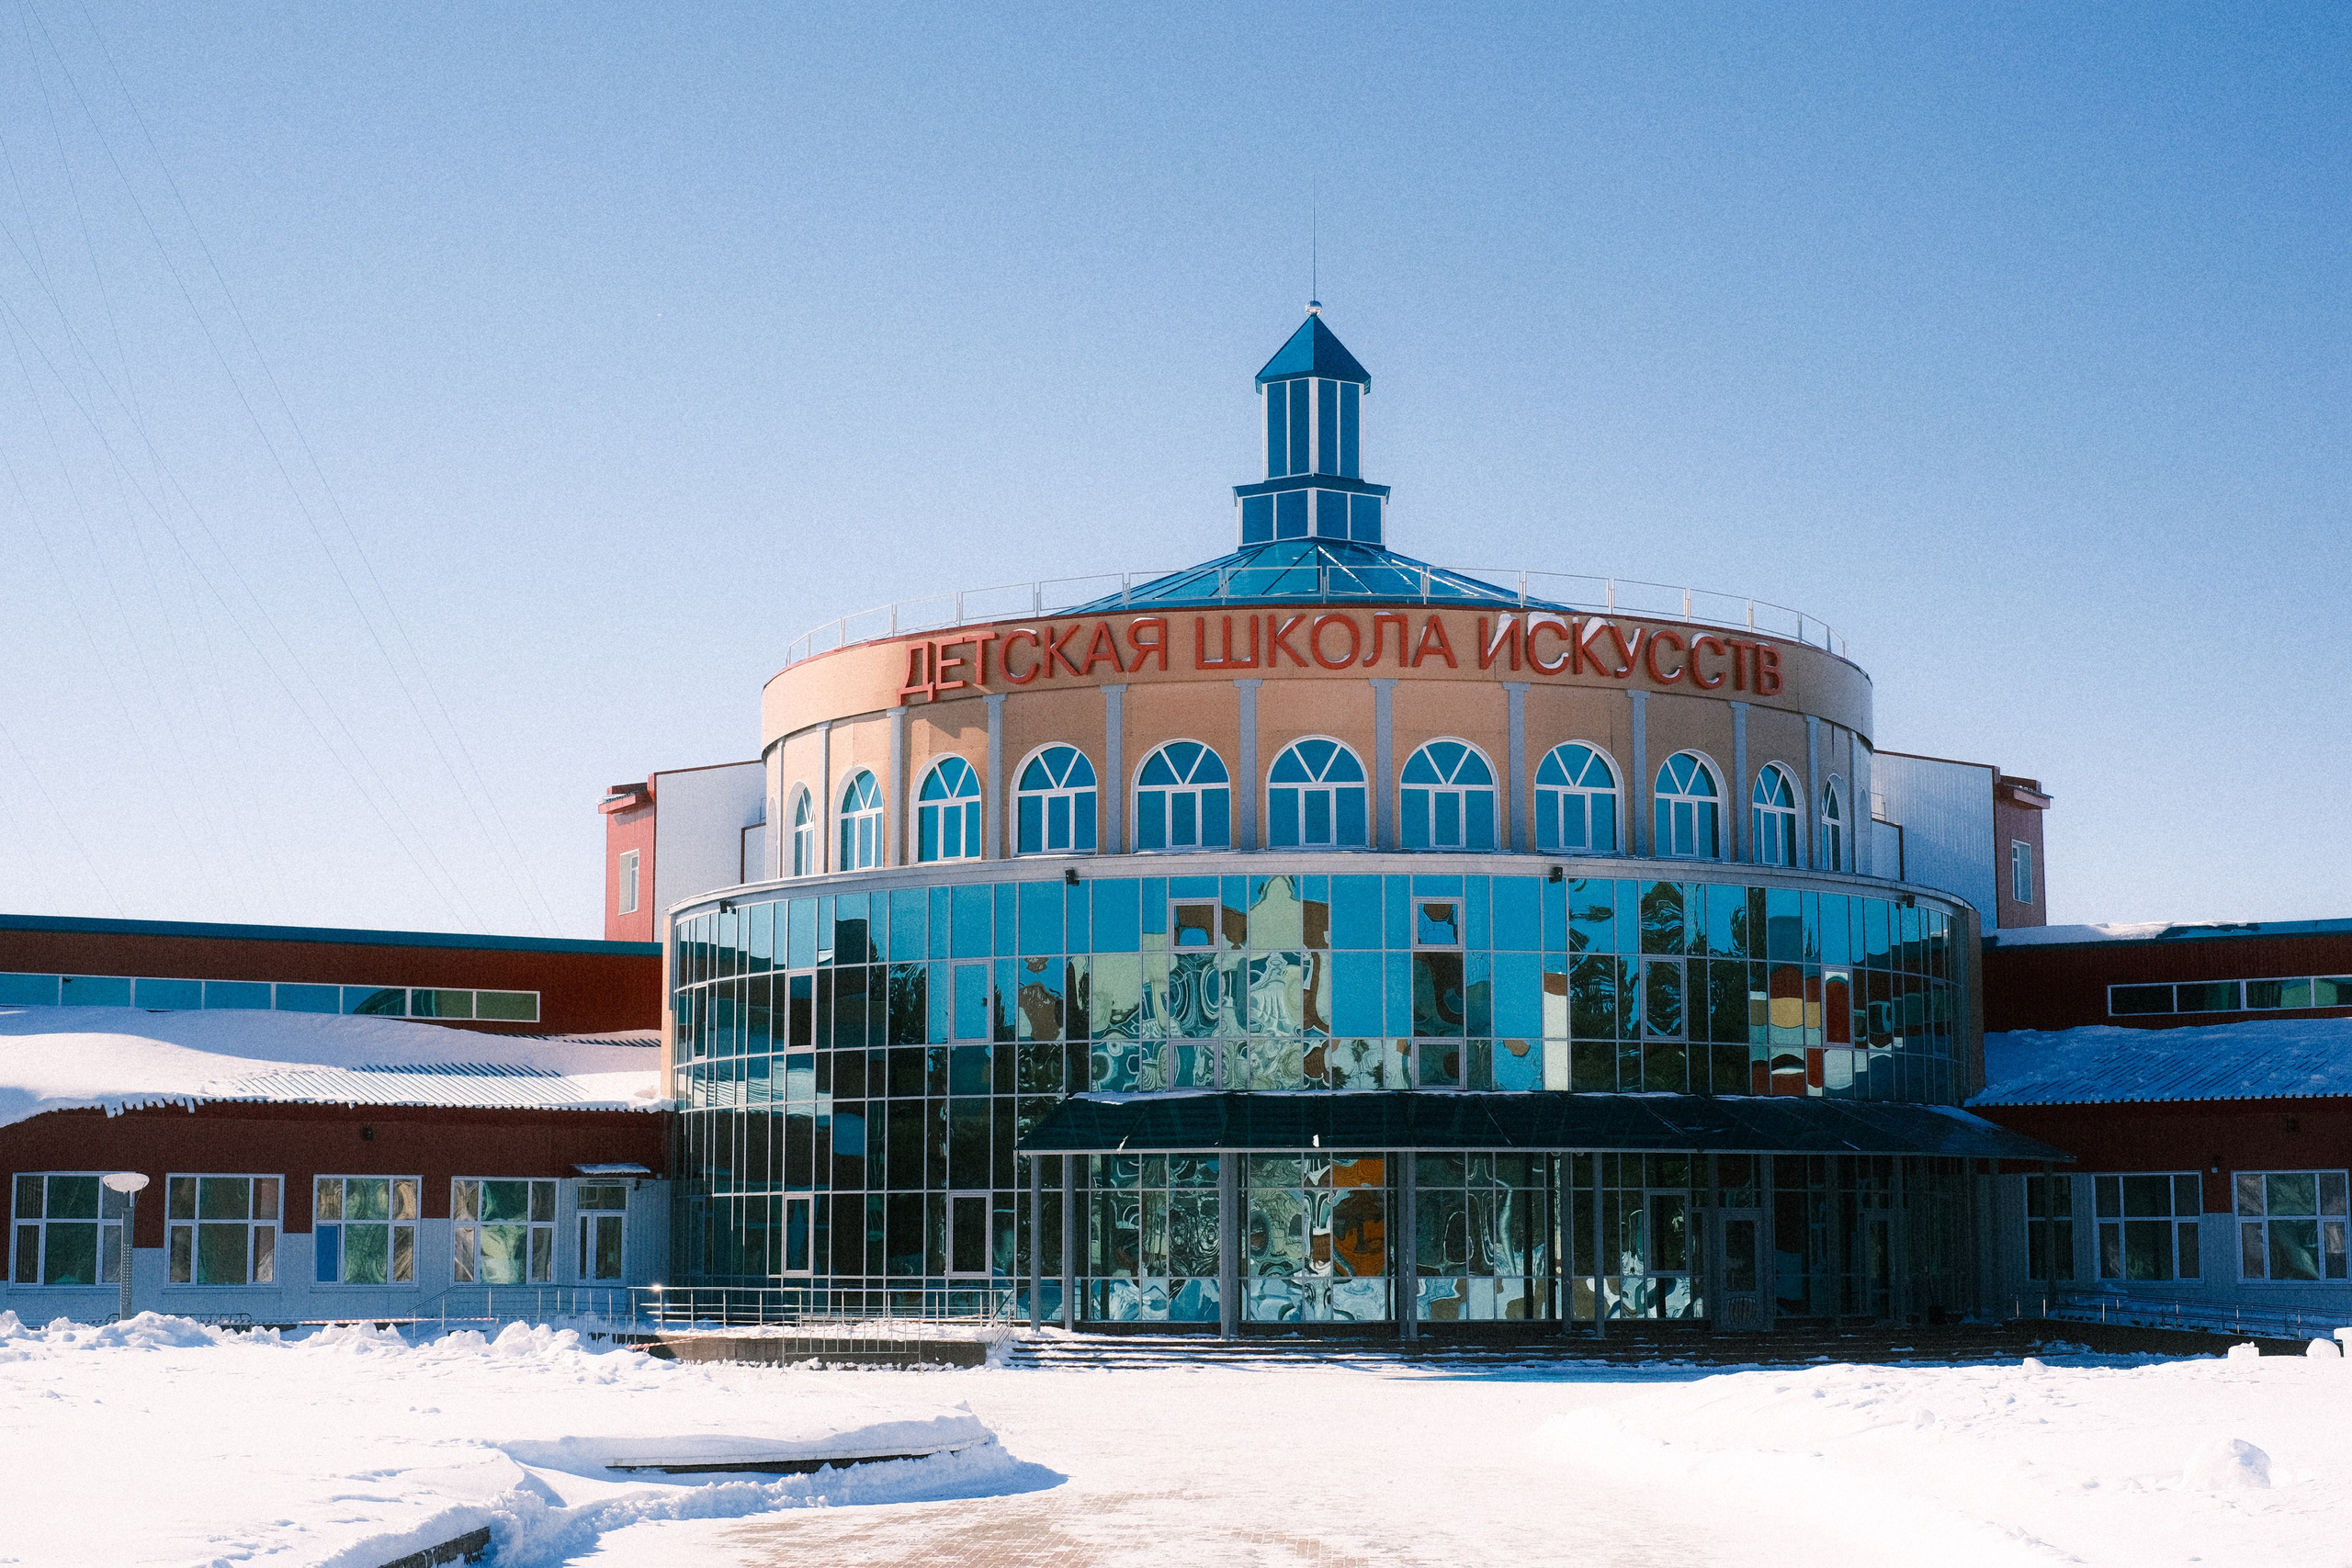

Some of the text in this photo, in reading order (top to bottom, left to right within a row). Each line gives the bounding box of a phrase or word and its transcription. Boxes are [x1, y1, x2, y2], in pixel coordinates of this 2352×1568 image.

[897, 613, 1784, 705] ДЕТСКАЯ ШКОЛА ИСКУССТВ
